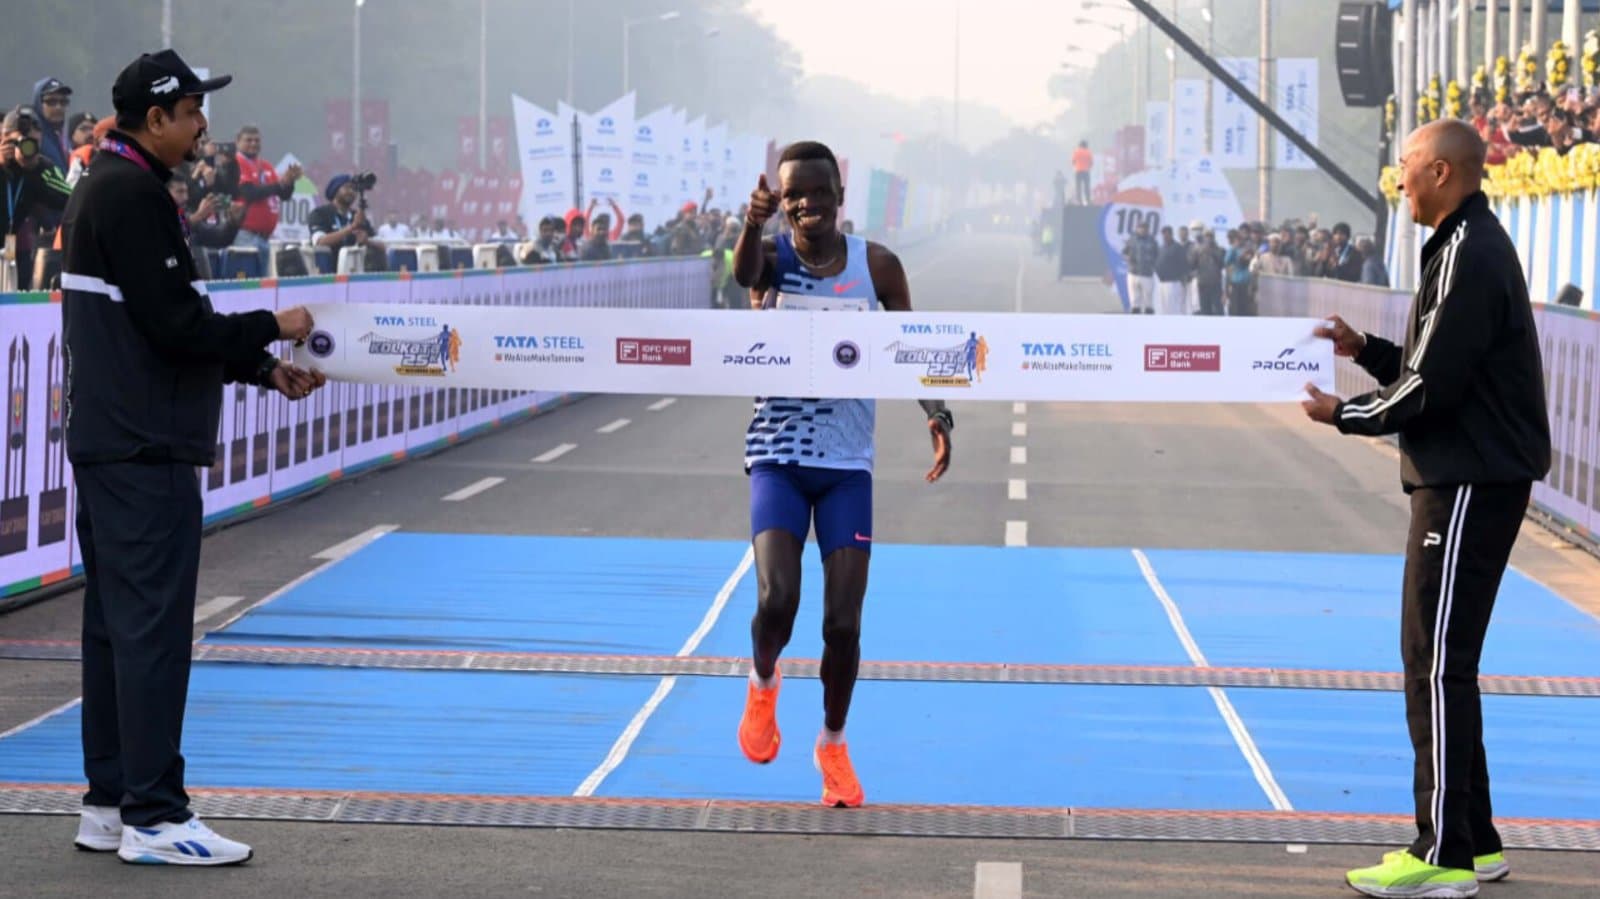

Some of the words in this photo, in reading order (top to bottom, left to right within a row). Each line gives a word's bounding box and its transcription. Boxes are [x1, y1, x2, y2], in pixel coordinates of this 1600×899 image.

[1116, 207, 1160, 237] 100
[374, 316, 405, 326] TATA
[408, 317, 437, 327] STEEL
[901, 324, 932, 334] TATA
[935, 324, 964, 335] STEEL
[494, 335, 538, 348] TATA
[543, 336, 585, 349] STEEL
[642, 345, 661, 353] IDFC
[663, 345, 687, 353] FIRST
[1022, 344, 1066, 356] TATA
[1070, 344, 1112, 357] STEEL
[723, 355, 791, 365] PROCAM
[1170, 351, 1190, 360] IDFC
[1192, 351, 1216, 360] FIRST
[1170, 360, 1191, 368] Bank
[1252, 360, 1320, 371] PROCAM
